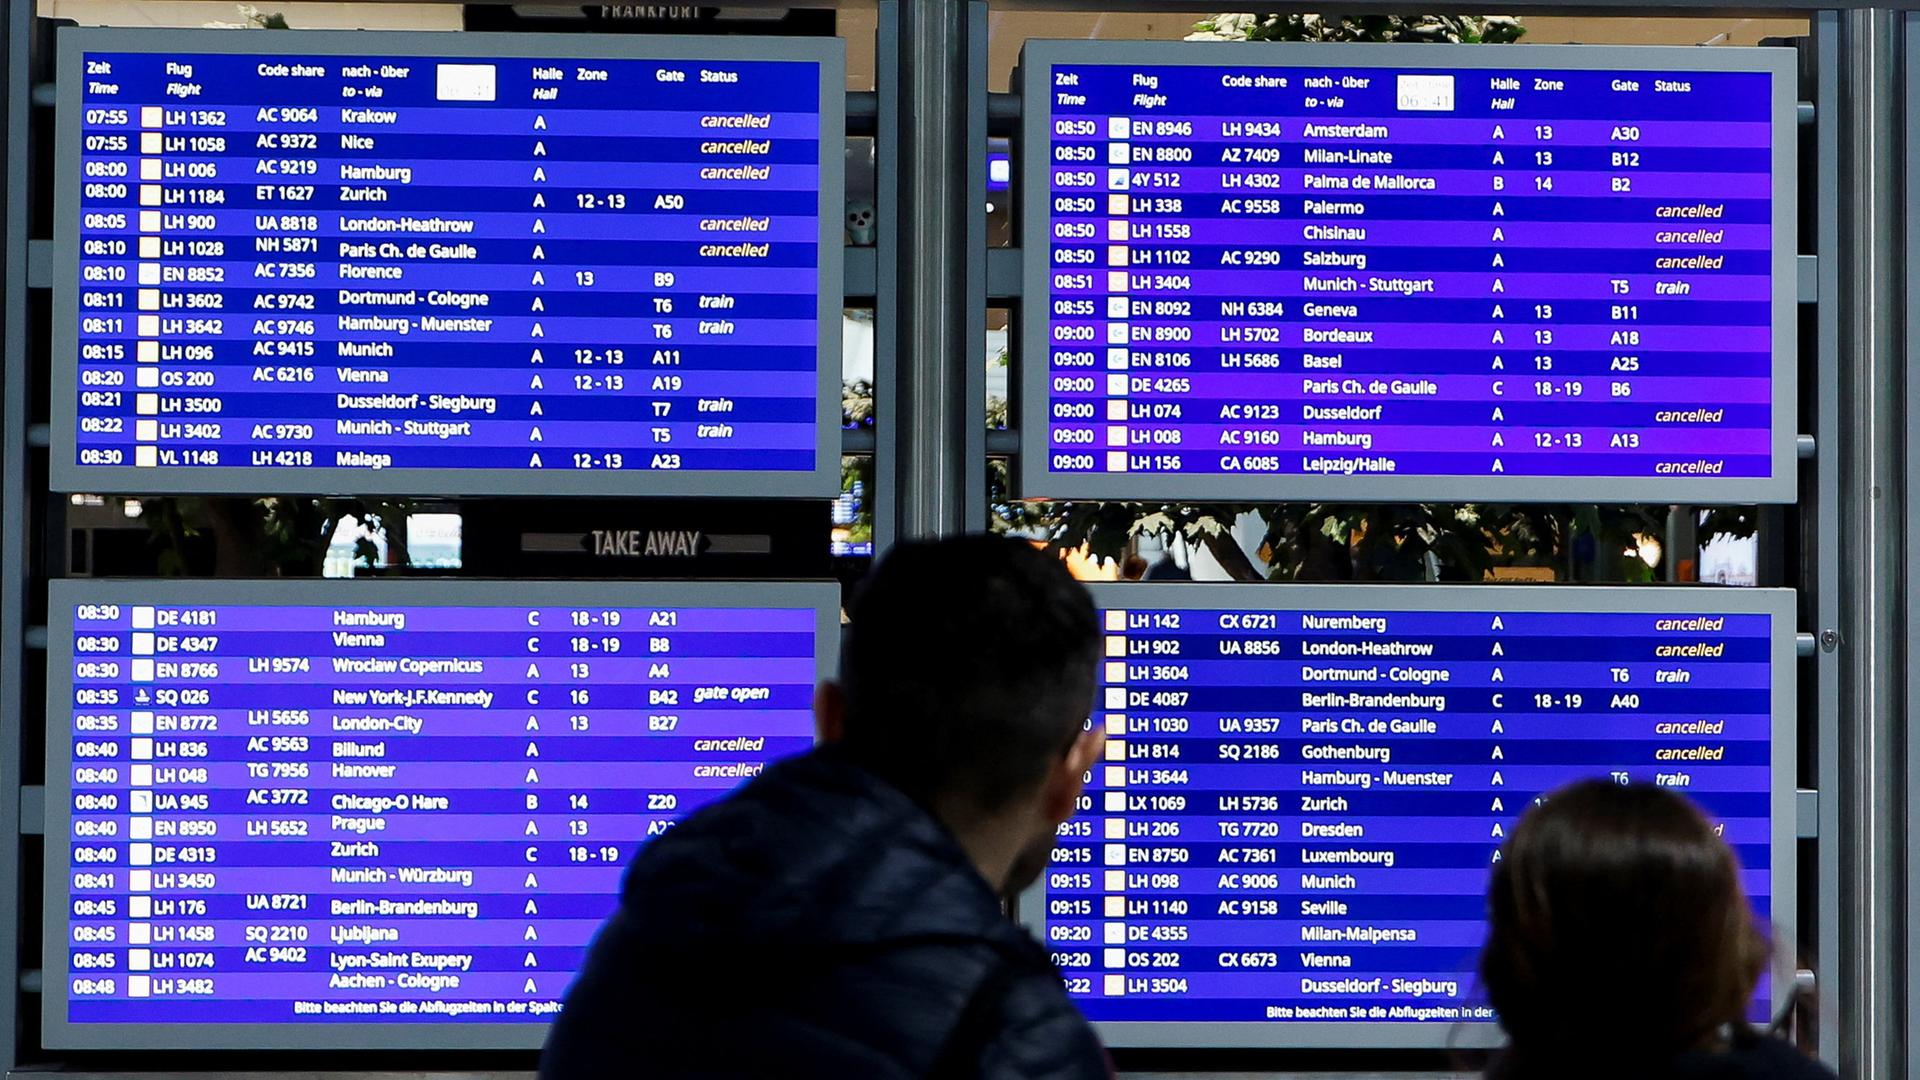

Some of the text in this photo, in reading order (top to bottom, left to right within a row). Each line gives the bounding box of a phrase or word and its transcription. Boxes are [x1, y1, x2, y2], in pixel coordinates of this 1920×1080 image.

[87, 61, 112, 74] Zeit
[166, 62, 193, 79] Flug
[257, 63, 326, 77] Code share
[342, 64, 410, 78] nach über
[532, 67, 564, 80] Halle
[576, 67, 608, 81] Zone
[656, 69, 685, 82] Gate
[700, 69, 738, 83] Status
[1055, 72, 1079, 86] Zeit
[1132, 73, 1158, 90] Flug
[1221, 74, 1288, 88] Code share
[1304, 75, 1370, 89] nach über
[1490, 77, 1521, 90] Halle
[88, 81, 119, 95] Time
[166, 82, 202, 98] Flight
[342, 85, 383, 98] to via
[1534, 78, 1564, 91] Zone
[1611, 79, 1640, 92] Gate
[1654, 79, 1692, 92] Status
[532, 87, 559, 100] Hall
[1057, 93, 1087, 106] Time
[1132, 93, 1168, 109] Flight
[1304, 96, 1344, 108] to via
[1490, 97, 1515, 110] Hall
[86, 109, 128, 125] 07:55
[341, 108, 397, 124] Krakow
[700, 113, 771, 129] cancelled
[1055, 120, 1096, 135] 08:50
[1303, 123, 1388, 138] Amsterdam
[1610, 126, 1640, 141] A30
[165, 136, 226, 152] LH 1058
[341, 134, 374, 150] Nice
[1132, 147, 1192, 162] EN 8800
[1304, 148, 1393, 164] Milan-Linate
[340, 164, 412, 184] Hamburg
[700, 165, 771, 180] cancelled
[1304, 174, 1436, 190] Palma de Mallorca
[256, 185, 315, 201] ET 1627
[339, 186, 387, 202] Zurich
[654, 194, 684, 210] A50
[1304, 199, 1365, 215] Palermo
[1655, 204, 1724, 218] cancelled
[84, 213, 127, 229] 08:05
[339, 216, 474, 233] London-Heathrow
[1303, 225, 1366, 240] Chisinau
[339, 242, 477, 259] Paris Ch. de Gaulle
[1220, 250, 1281, 265] AC 9290
[1303, 251, 1367, 270] Salzburg
[1655, 255, 1724, 269] cancelled
[339, 263, 403, 279] Florence
[1054, 274, 1093, 289] 08:51
[1655, 280, 1690, 295] train
[698, 294, 735, 309] train
[1303, 302, 1358, 317] Geneva
[1054, 325, 1095, 340] 09:00
[1303, 328, 1374, 343] Bordeaux
[82, 344, 124, 360] 08:15
[338, 341, 393, 357] Munich
[1303, 353, 1342, 369] Basel
[336, 367, 389, 383] Vienna
[1303, 379, 1438, 395] Paris Ch. de Gaulle
[1303, 405, 1383, 420] Dusseldorf
[1303, 430, 1372, 450] Hamburg
[336, 451, 392, 470] Malaga
[1303, 456, 1396, 476] Leipzig/Halle
[591, 530, 700, 556] TAKE AWAY
[333, 609, 405, 630] Hamburg
[1302, 614, 1386, 633] Nuremberg
[1655, 616, 1724, 631] cancelled
[332, 631, 385, 647] Vienna
[1302, 640, 1434, 656] London-Heathrow
[398, 657, 484, 677] Copernicus
[1655, 668, 1690, 683] train
[76, 689, 119, 705] 08:35
[333, 689, 368, 705] New
[693, 686, 770, 703] gate open
[1302, 692, 1445, 712] Berlin-Brandenburg
[155, 715, 218, 731] EN 8772
[332, 714, 423, 735] London-City
[1129, 717, 1189, 732] LH 1030
[1302, 718, 1437, 733] Paris Ch. de Gaulle
[1655, 719, 1724, 734] cancelled
[332, 741, 385, 757] Billund
[693, 736, 765, 752] cancelled
[1219, 744, 1280, 761] SQ 2186
[1301, 744, 1390, 763] Gothenburg
[332, 762, 397, 778] Hanover
[411, 794, 449, 810] Hare
[1301, 796, 1348, 811] Zurich
[331, 814, 386, 835] Prague
[1301, 822, 1363, 837] Dresden
[74, 847, 117, 863] 08:40
[330, 841, 379, 857] Zurich
[1051, 847, 1092, 863] 09:15
[1301, 848, 1394, 867] Luxembourg
[1301, 874, 1356, 889] Munich
[246, 894, 307, 910] UA 8721
[330, 899, 478, 919] Berlin-Brandenburg
[1301, 900, 1348, 915] Seville
[1050, 926, 1092, 941] 09:20
[1301, 926, 1416, 945] Milan-Malpensa
[411, 951, 473, 971] Exupery
[1300, 952, 1351, 967] Vienna
[295, 1001, 323, 1014] Bitte
[324, 1000, 378, 1014] beachten
[379, 1000, 398, 1014] Sie
[399, 1000, 419, 1014] die
[419, 1000, 492, 1016] Abflugzeiten
[493, 1000, 506, 1013] in
[507, 1000, 528, 1013] der
[1266, 1006, 1493, 1020] Bitte beachten Sie die Abflugzeiten in der
